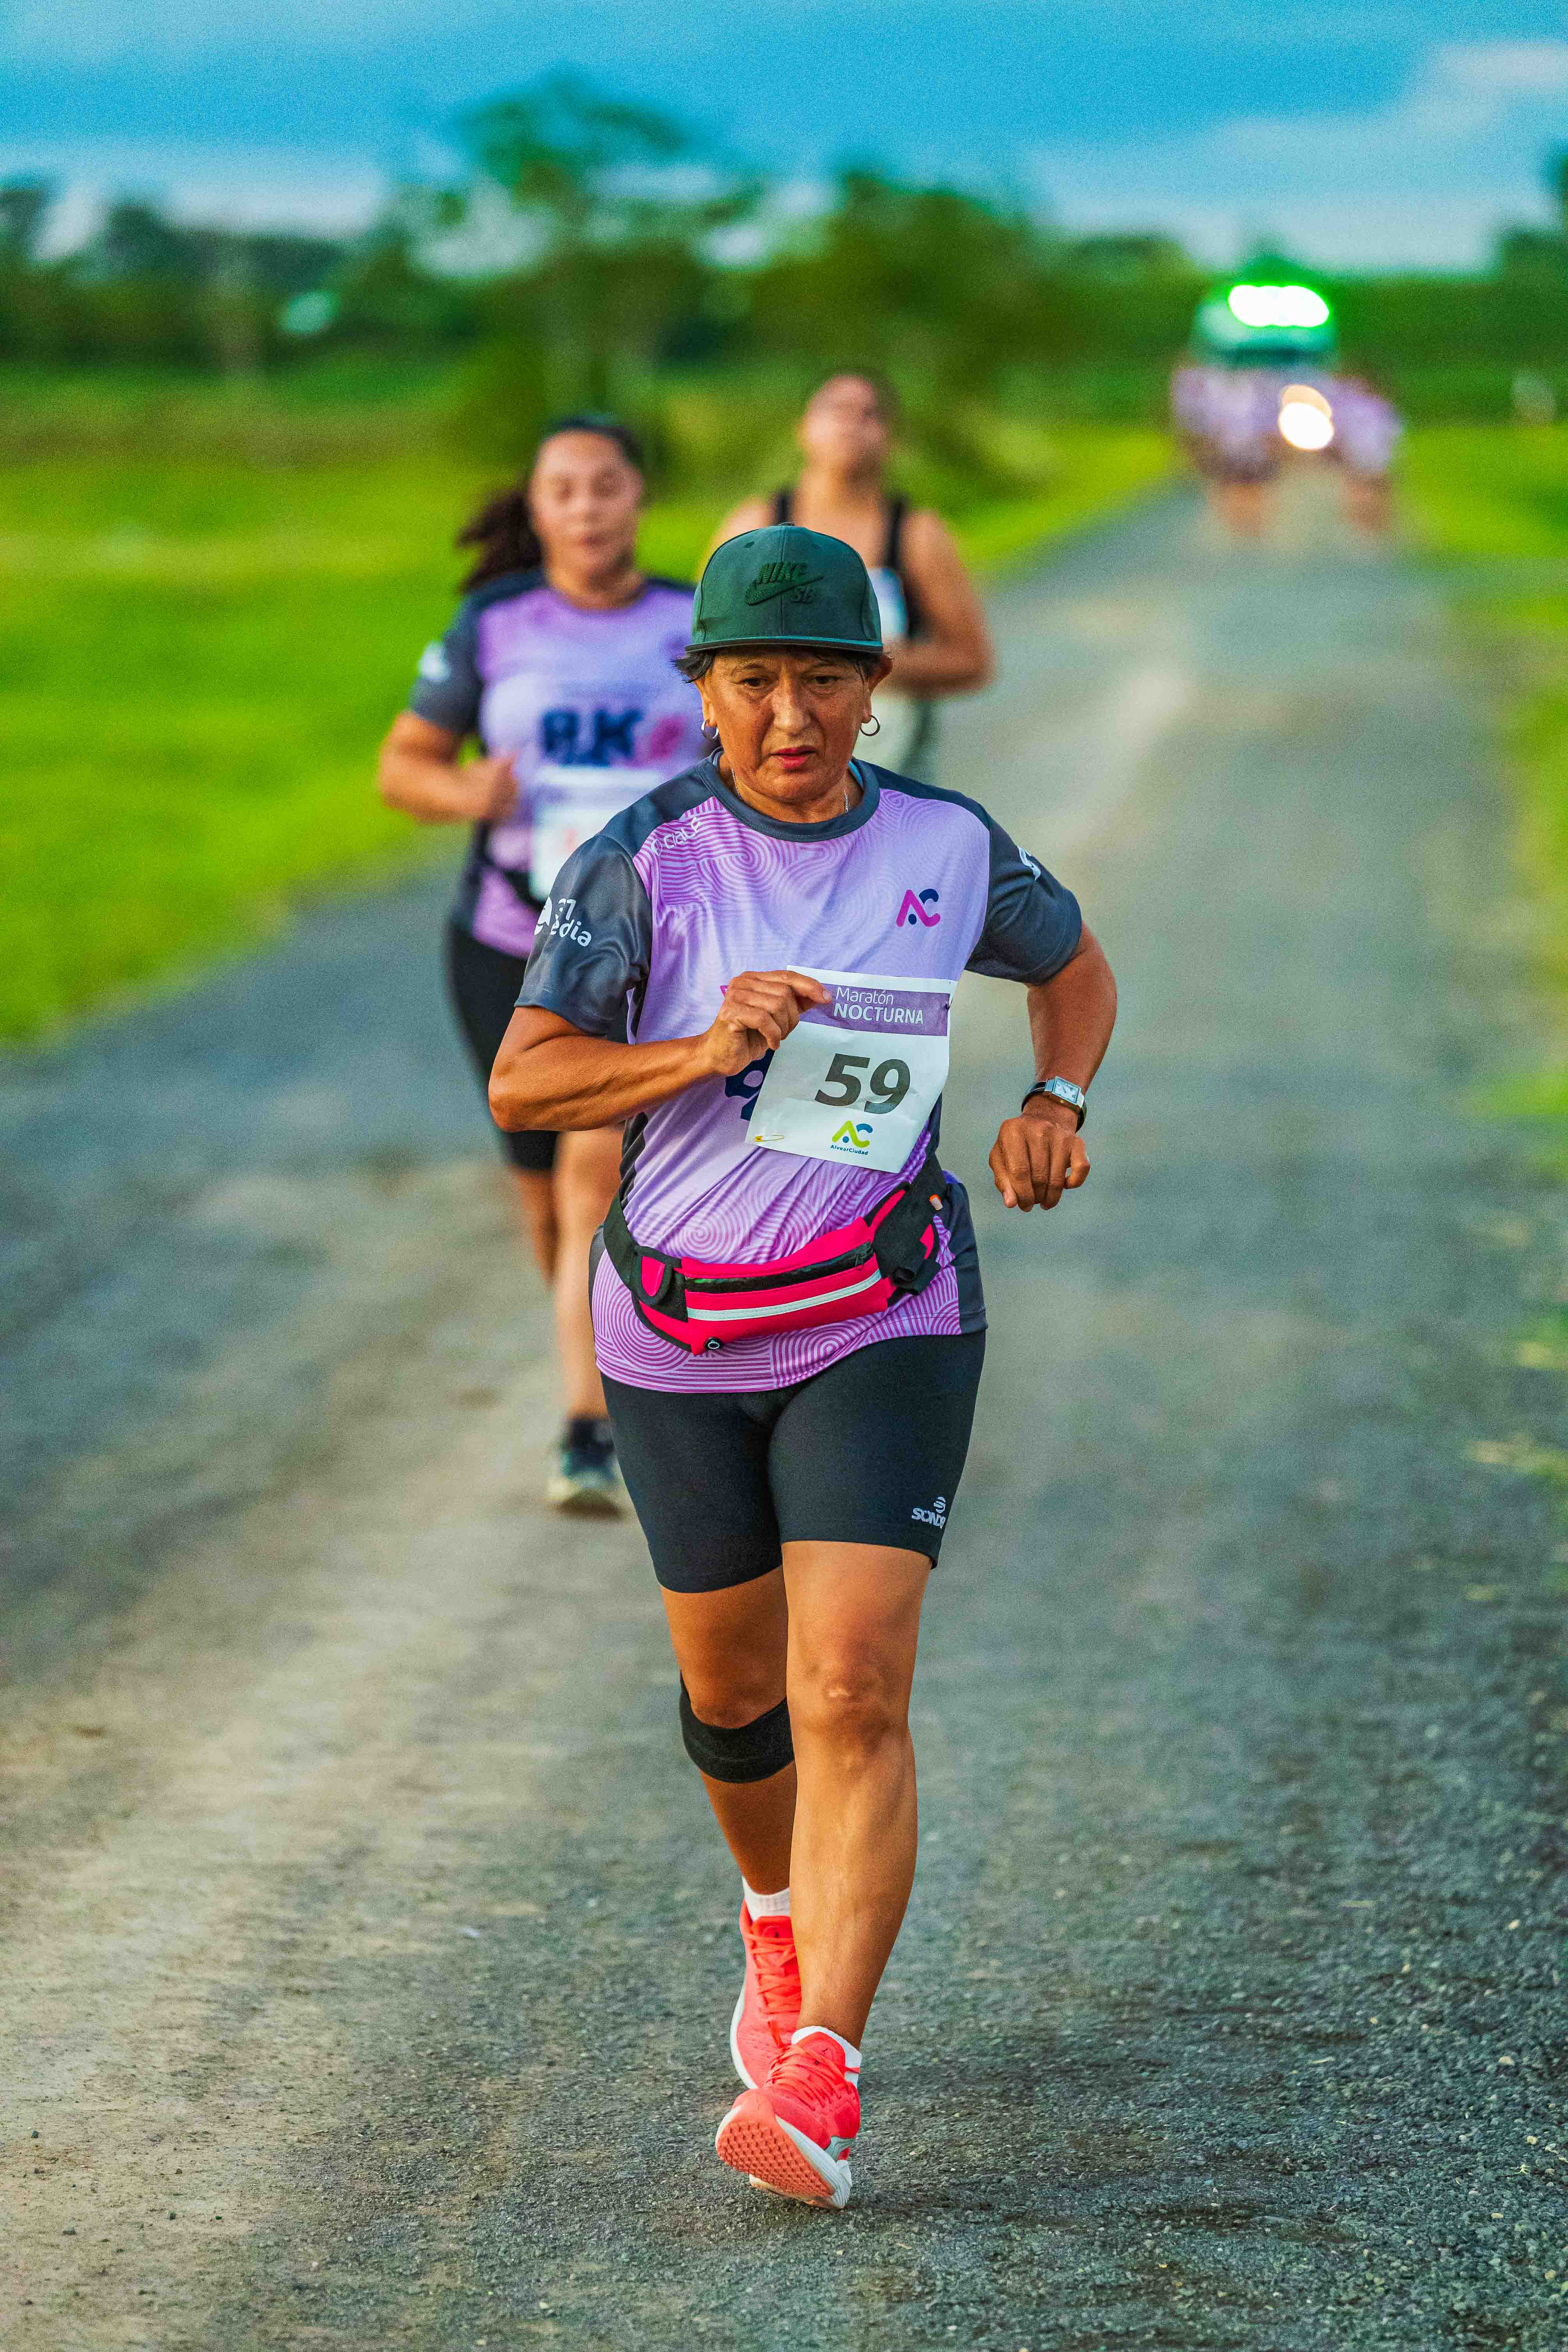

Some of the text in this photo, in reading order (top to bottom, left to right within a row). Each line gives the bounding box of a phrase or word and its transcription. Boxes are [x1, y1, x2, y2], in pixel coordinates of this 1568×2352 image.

[836, 986, 894, 1005] Maratón
[833, 1002, 923, 1024] NOCTURNA
[814, 1053, 911, 1115] 59
